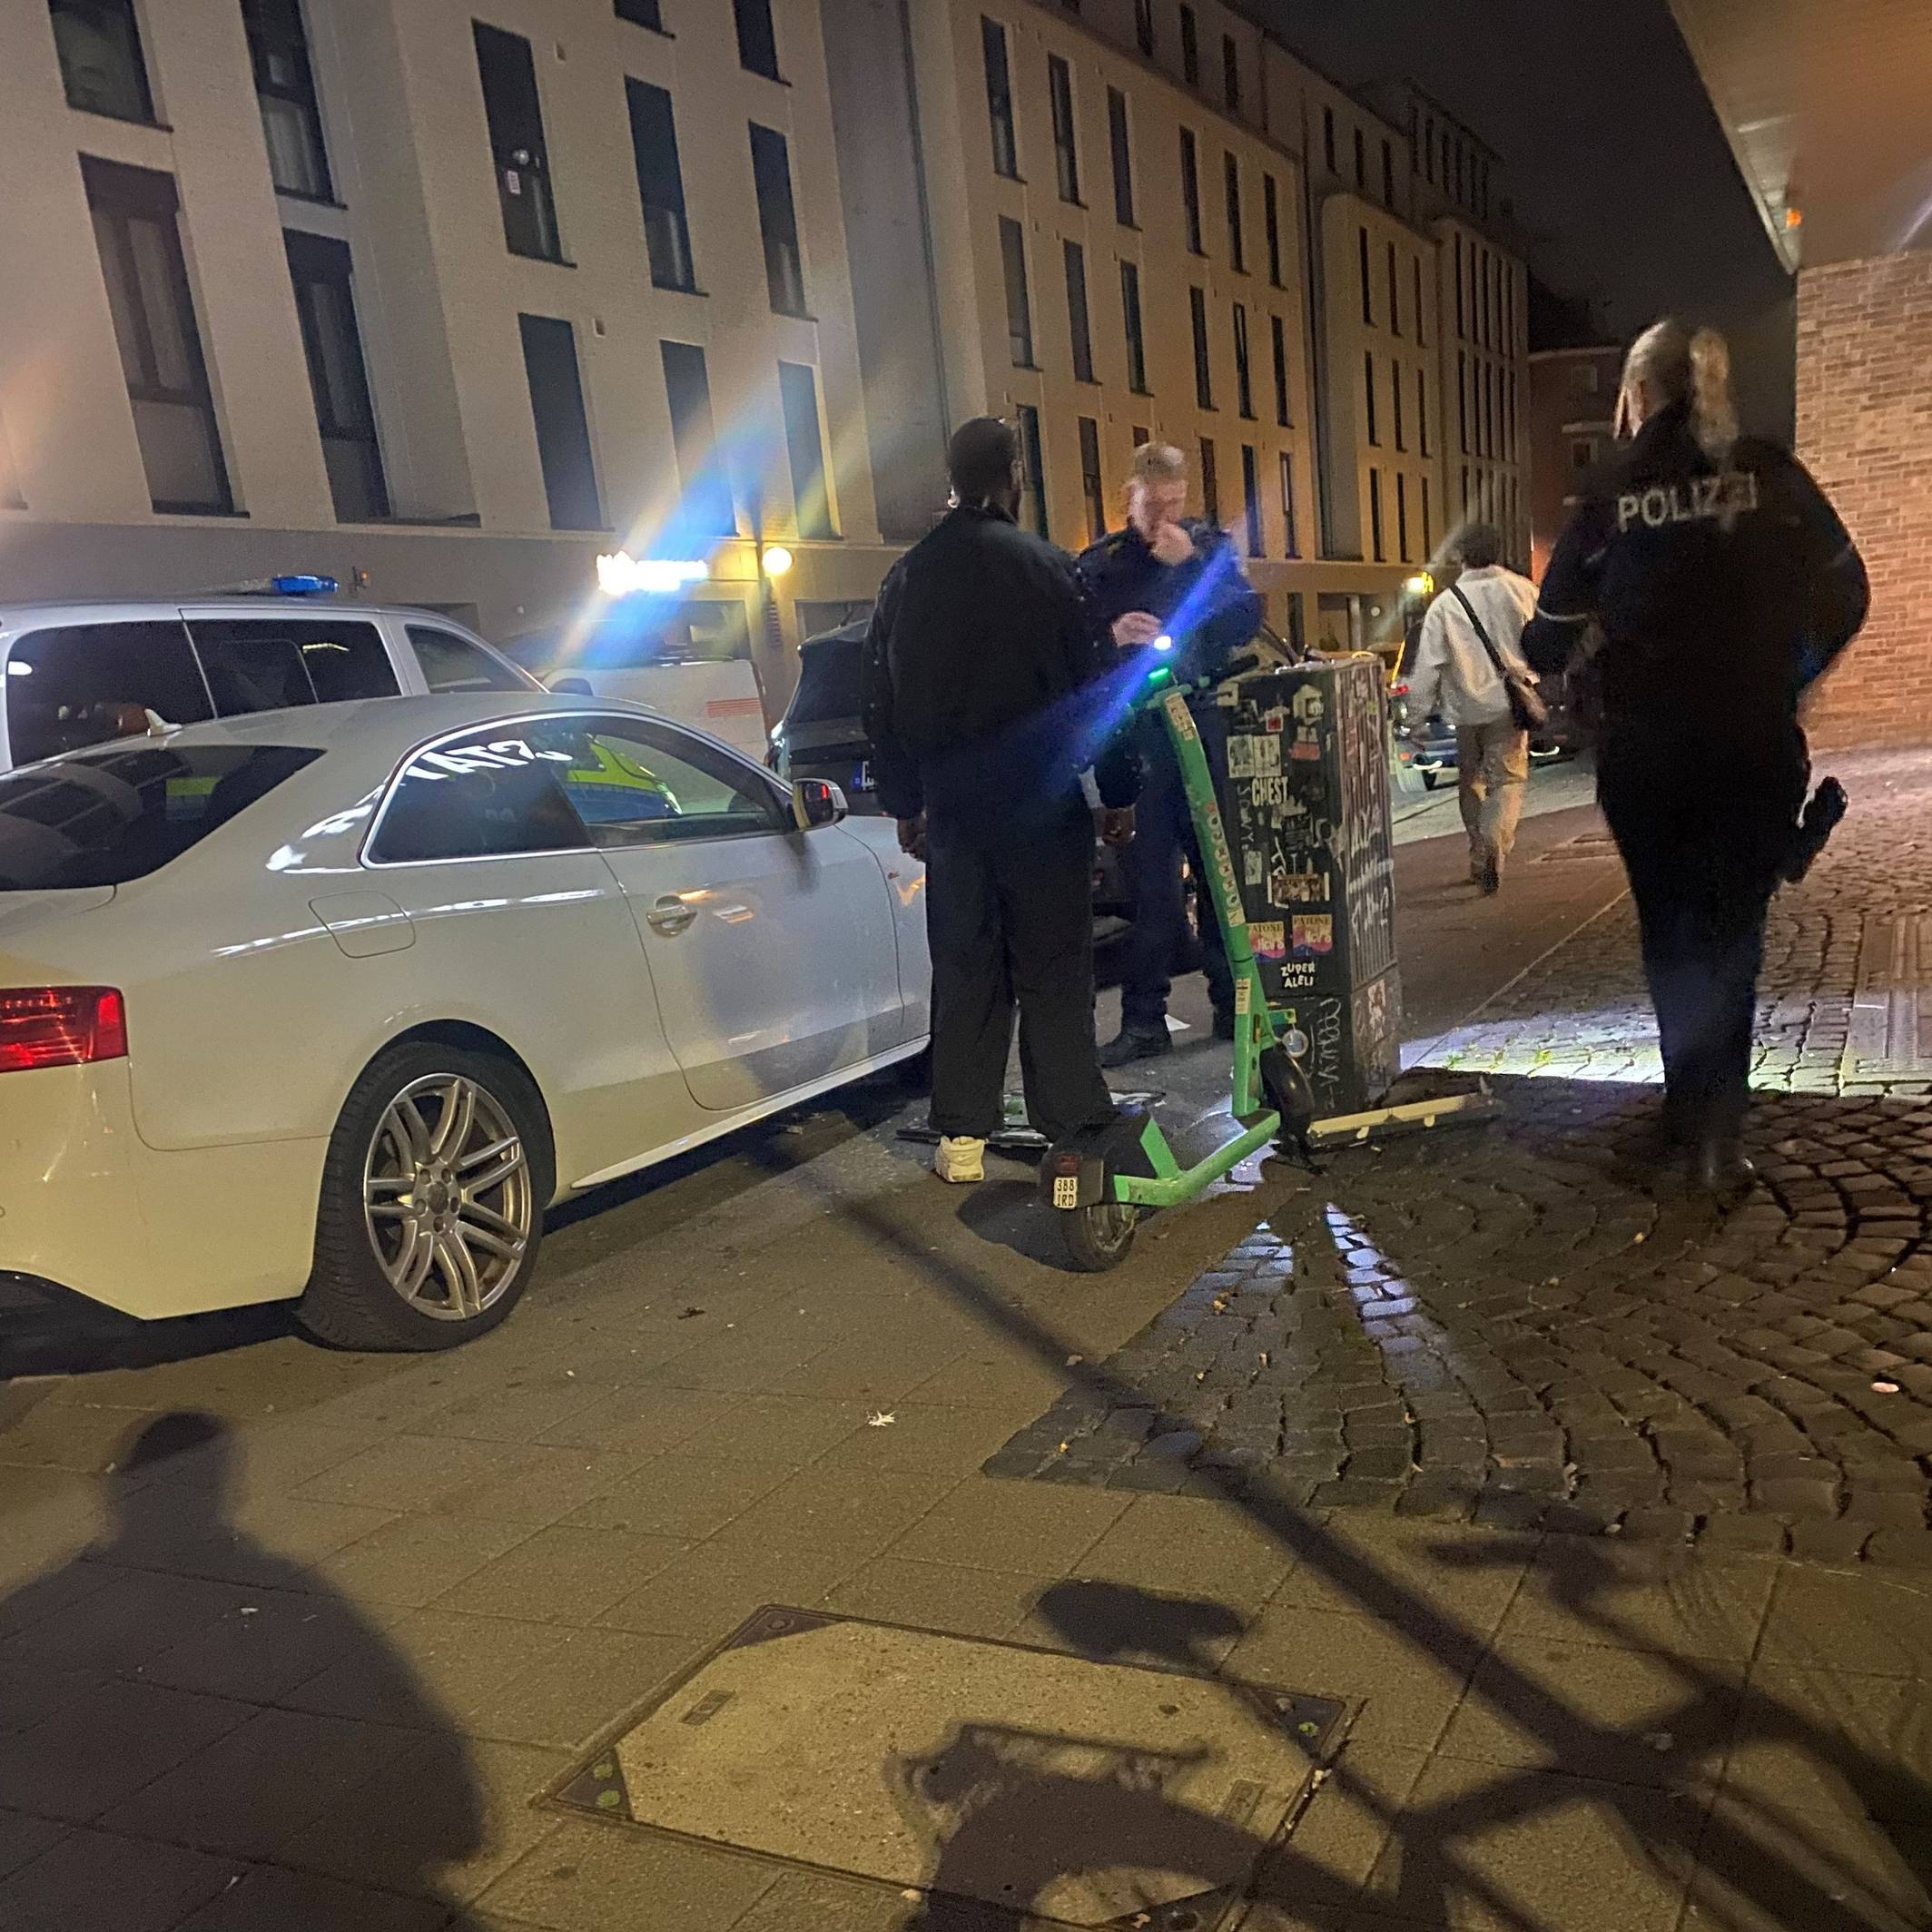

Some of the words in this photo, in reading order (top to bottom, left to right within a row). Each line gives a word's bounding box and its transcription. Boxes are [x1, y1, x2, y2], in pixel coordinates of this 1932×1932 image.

[1617, 471, 1759, 533] POLIZI
[1252, 776, 1288, 806] CHEST
[1280, 961, 1316, 977] ZUPER
[1284, 975, 1314, 988] ALELI
[1057, 1194, 1074, 1207] IRD
